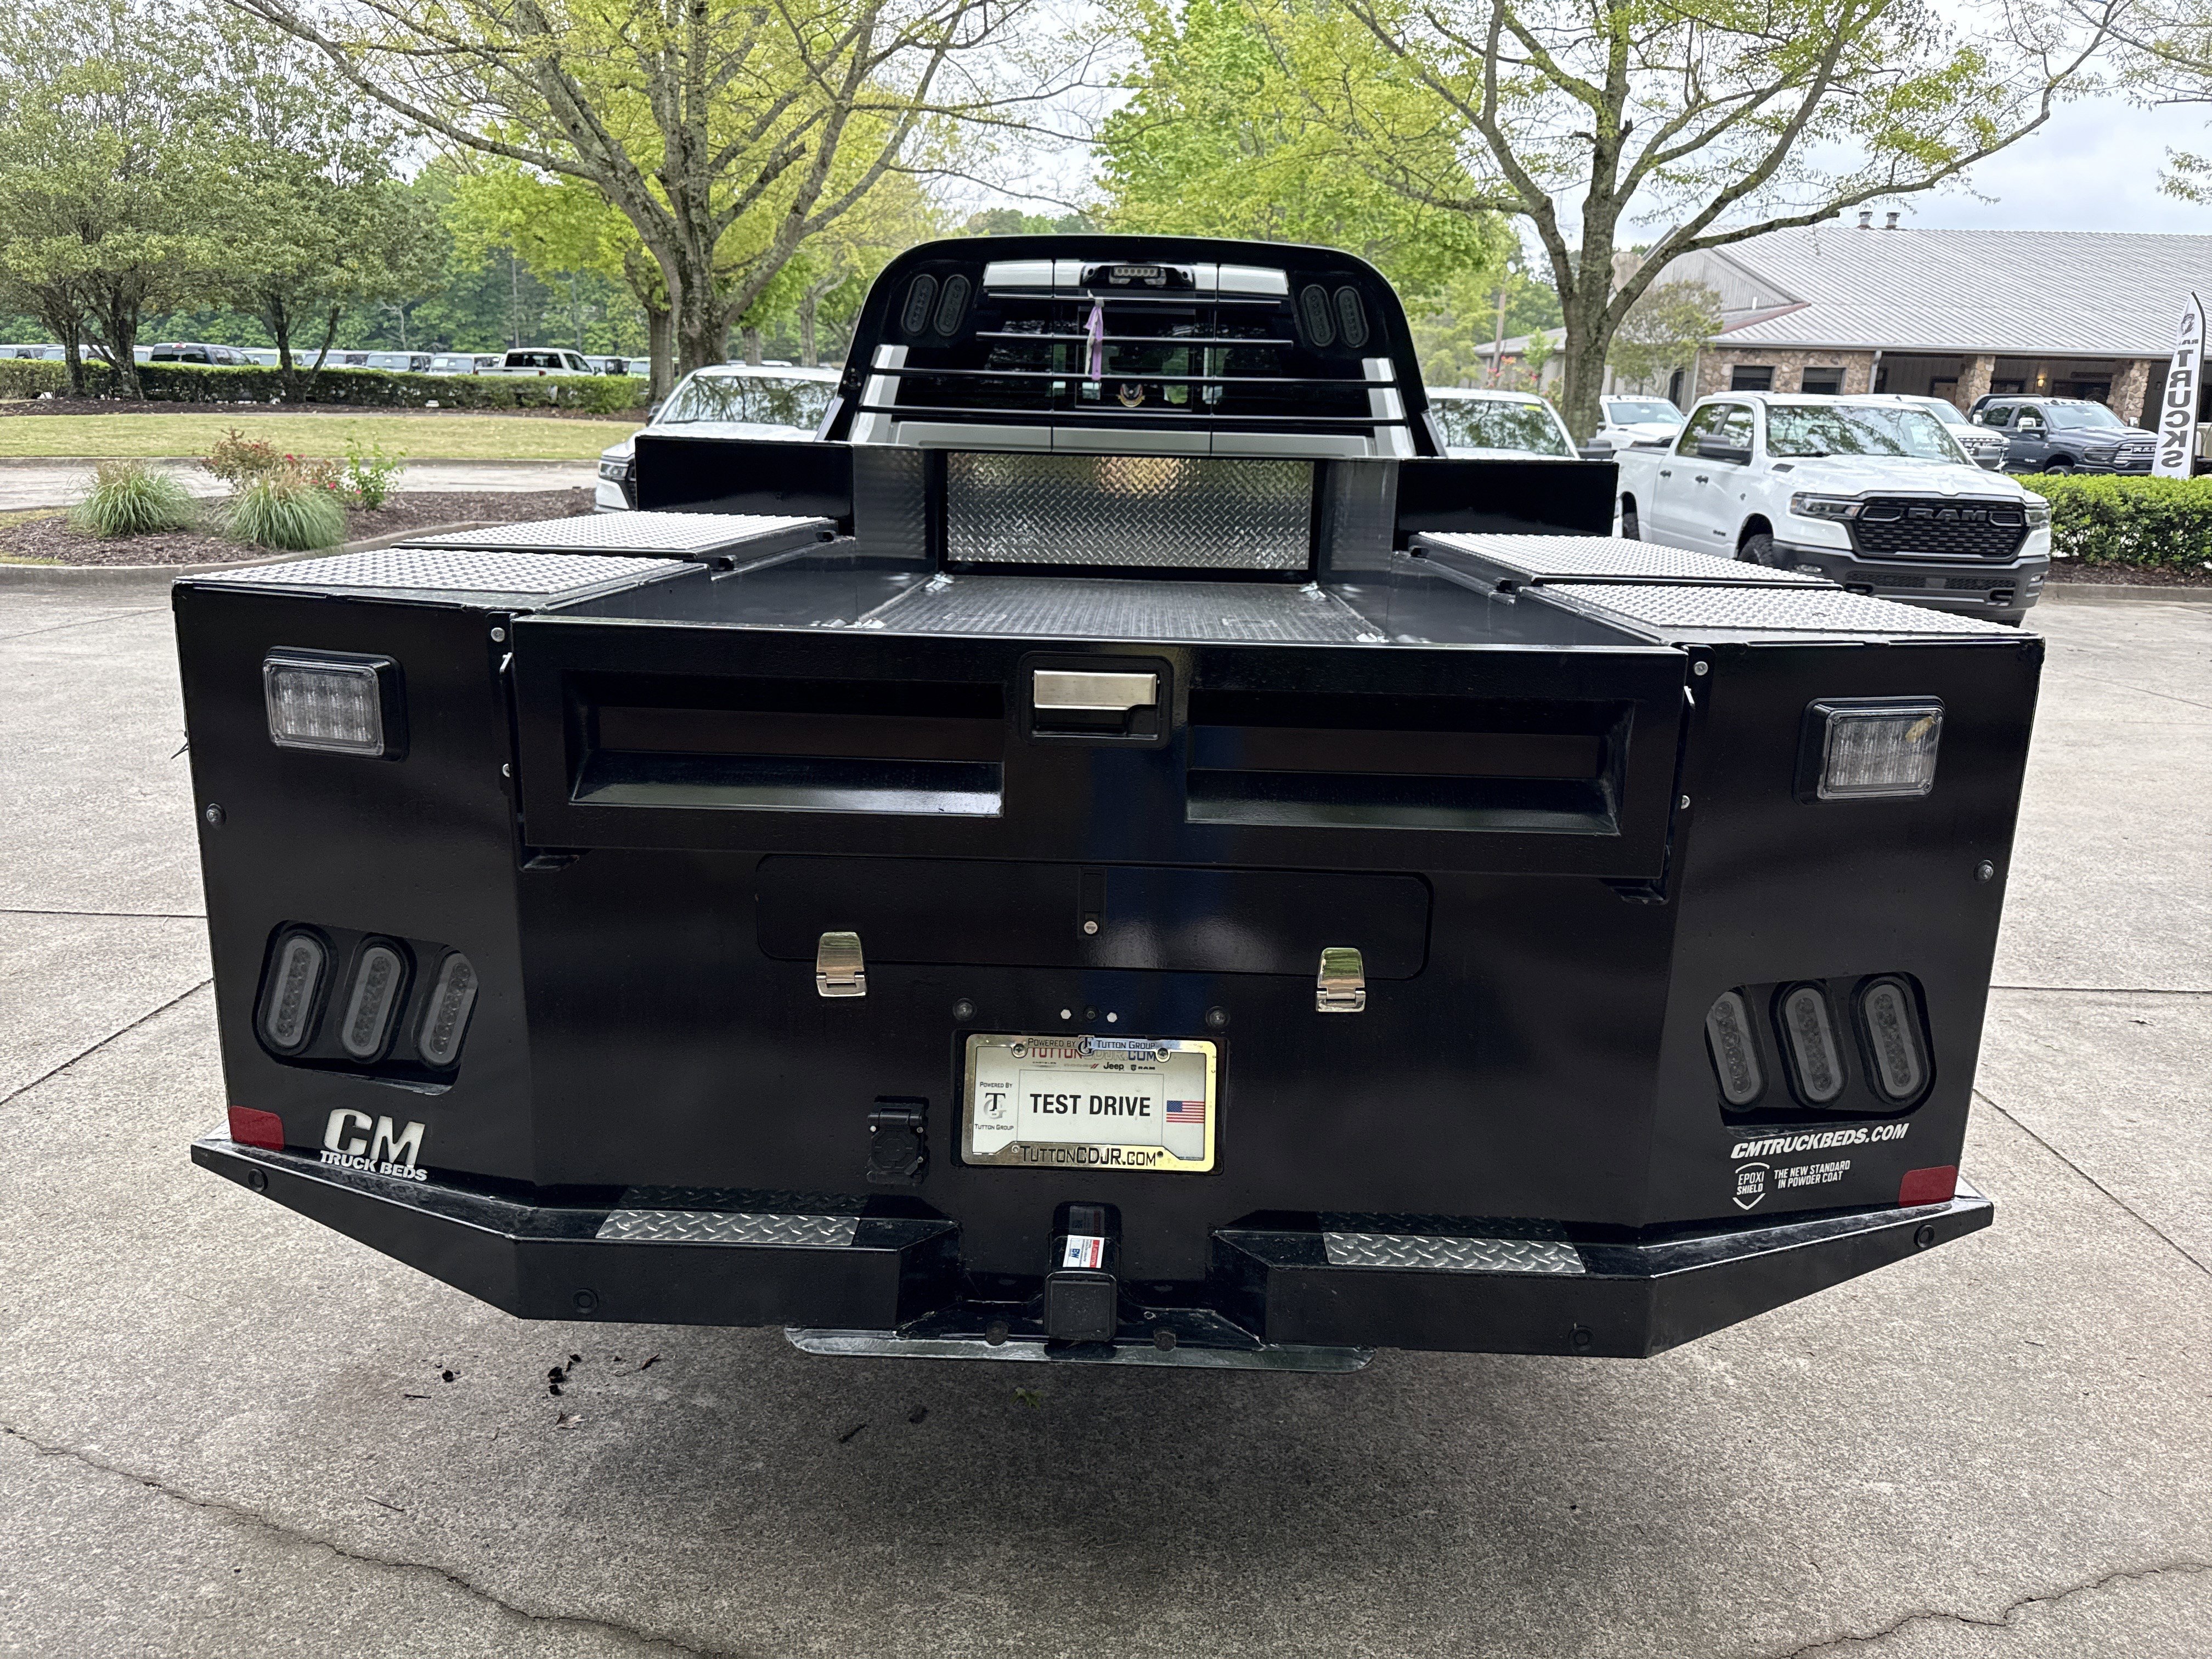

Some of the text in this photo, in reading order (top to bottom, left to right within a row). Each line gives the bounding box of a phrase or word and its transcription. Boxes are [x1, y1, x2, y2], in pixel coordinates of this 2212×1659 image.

[1909, 507, 1987, 521] RAM
[1028, 1037, 1064, 1047] POWERED
[1096, 1040, 1127, 1049] TUTTON
[1128, 1041, 1155, 1049] GROUP
[1103, 1062, 1124, 1071] Jeep
[1030, 1093, 1151, 1117] TEST DRIVE
[323, 1108, 426, 1169] CM
[1730, 1123, 1910, 1159] CMTRUCKBEDS.COM
[1019, 1145, 1156, 1166] TUTTONCDJR.COM
[320, 1150, 428, 1181] TRUCK BEDS
[1774, 1160, 1851, 1180] THE NEW STANDARD
[1737, 1171, 1765, 1186] EPOXI
[1778, 1170, 1843, 1189] IN POWDER COAT
[1736, 1183, 1764, 1195] SHIELD
